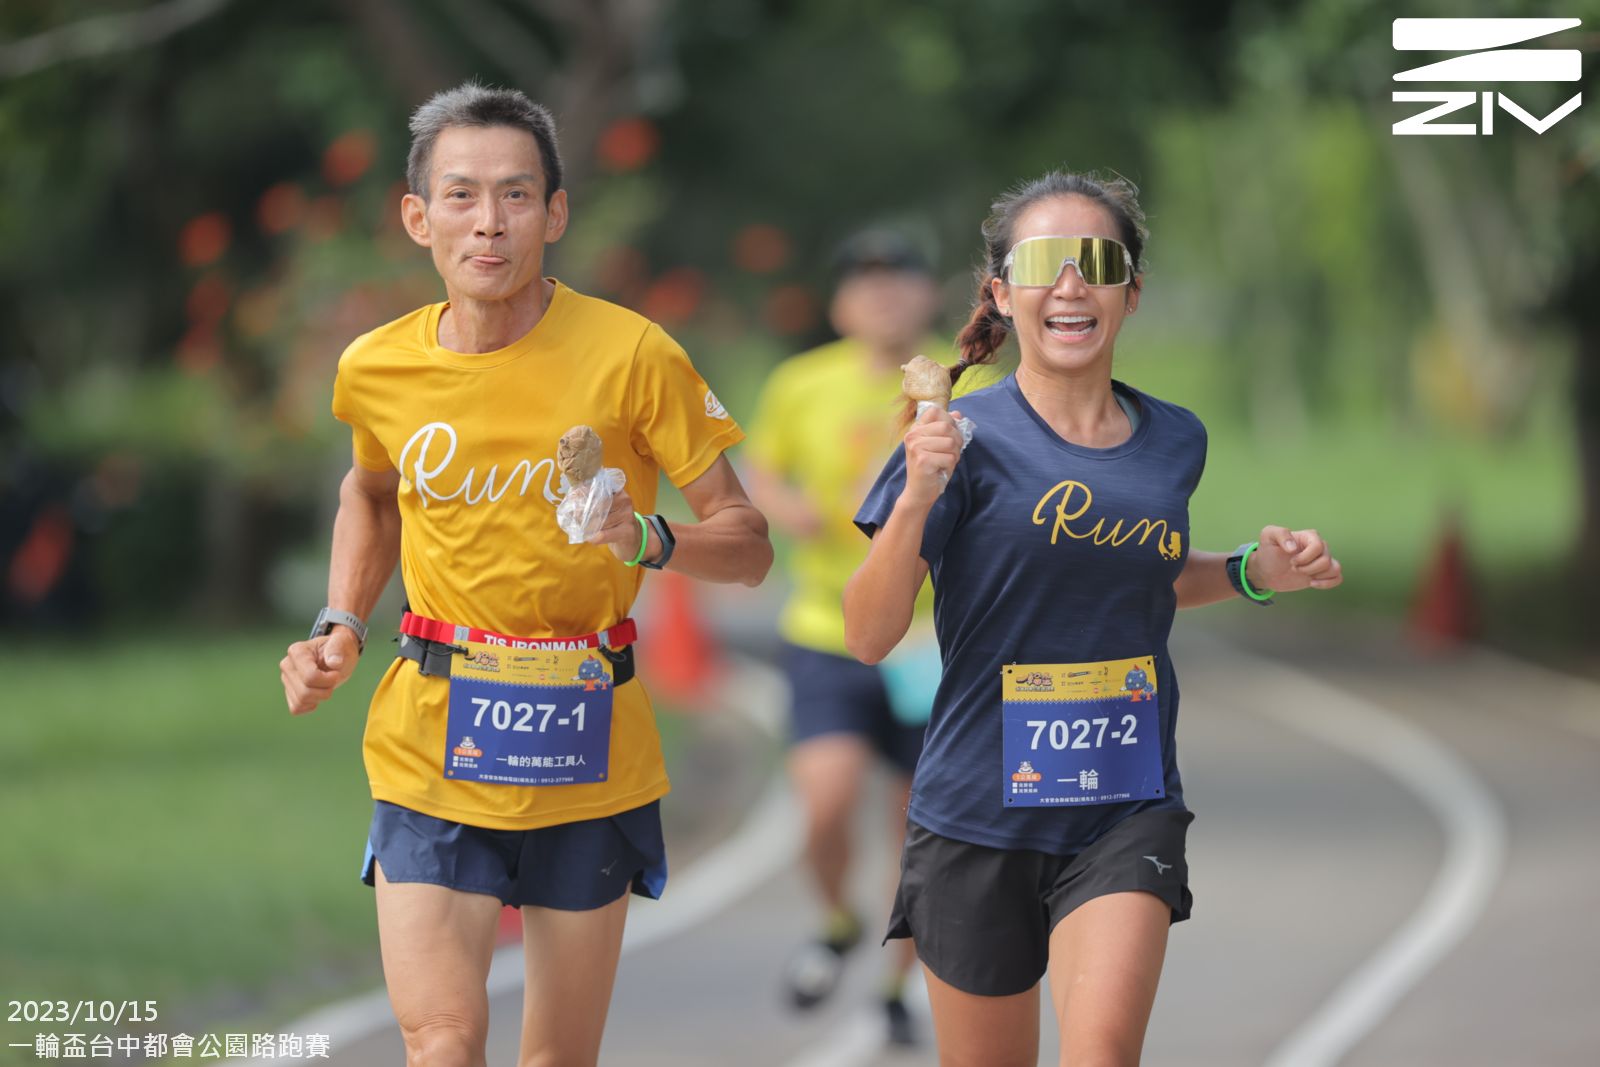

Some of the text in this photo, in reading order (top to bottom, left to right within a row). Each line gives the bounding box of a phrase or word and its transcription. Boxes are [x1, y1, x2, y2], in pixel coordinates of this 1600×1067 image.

[399, 421, 563, 509] Run
[1032, 480, 1170, 557] Run
[471, 697, 586, 733] 7027-1
[1026, 714, 1138, 750] 7027-2
[496, 755, 586, 769] 一輪的萬能工具人
[1056, 769, 1099, 791] 一輪
